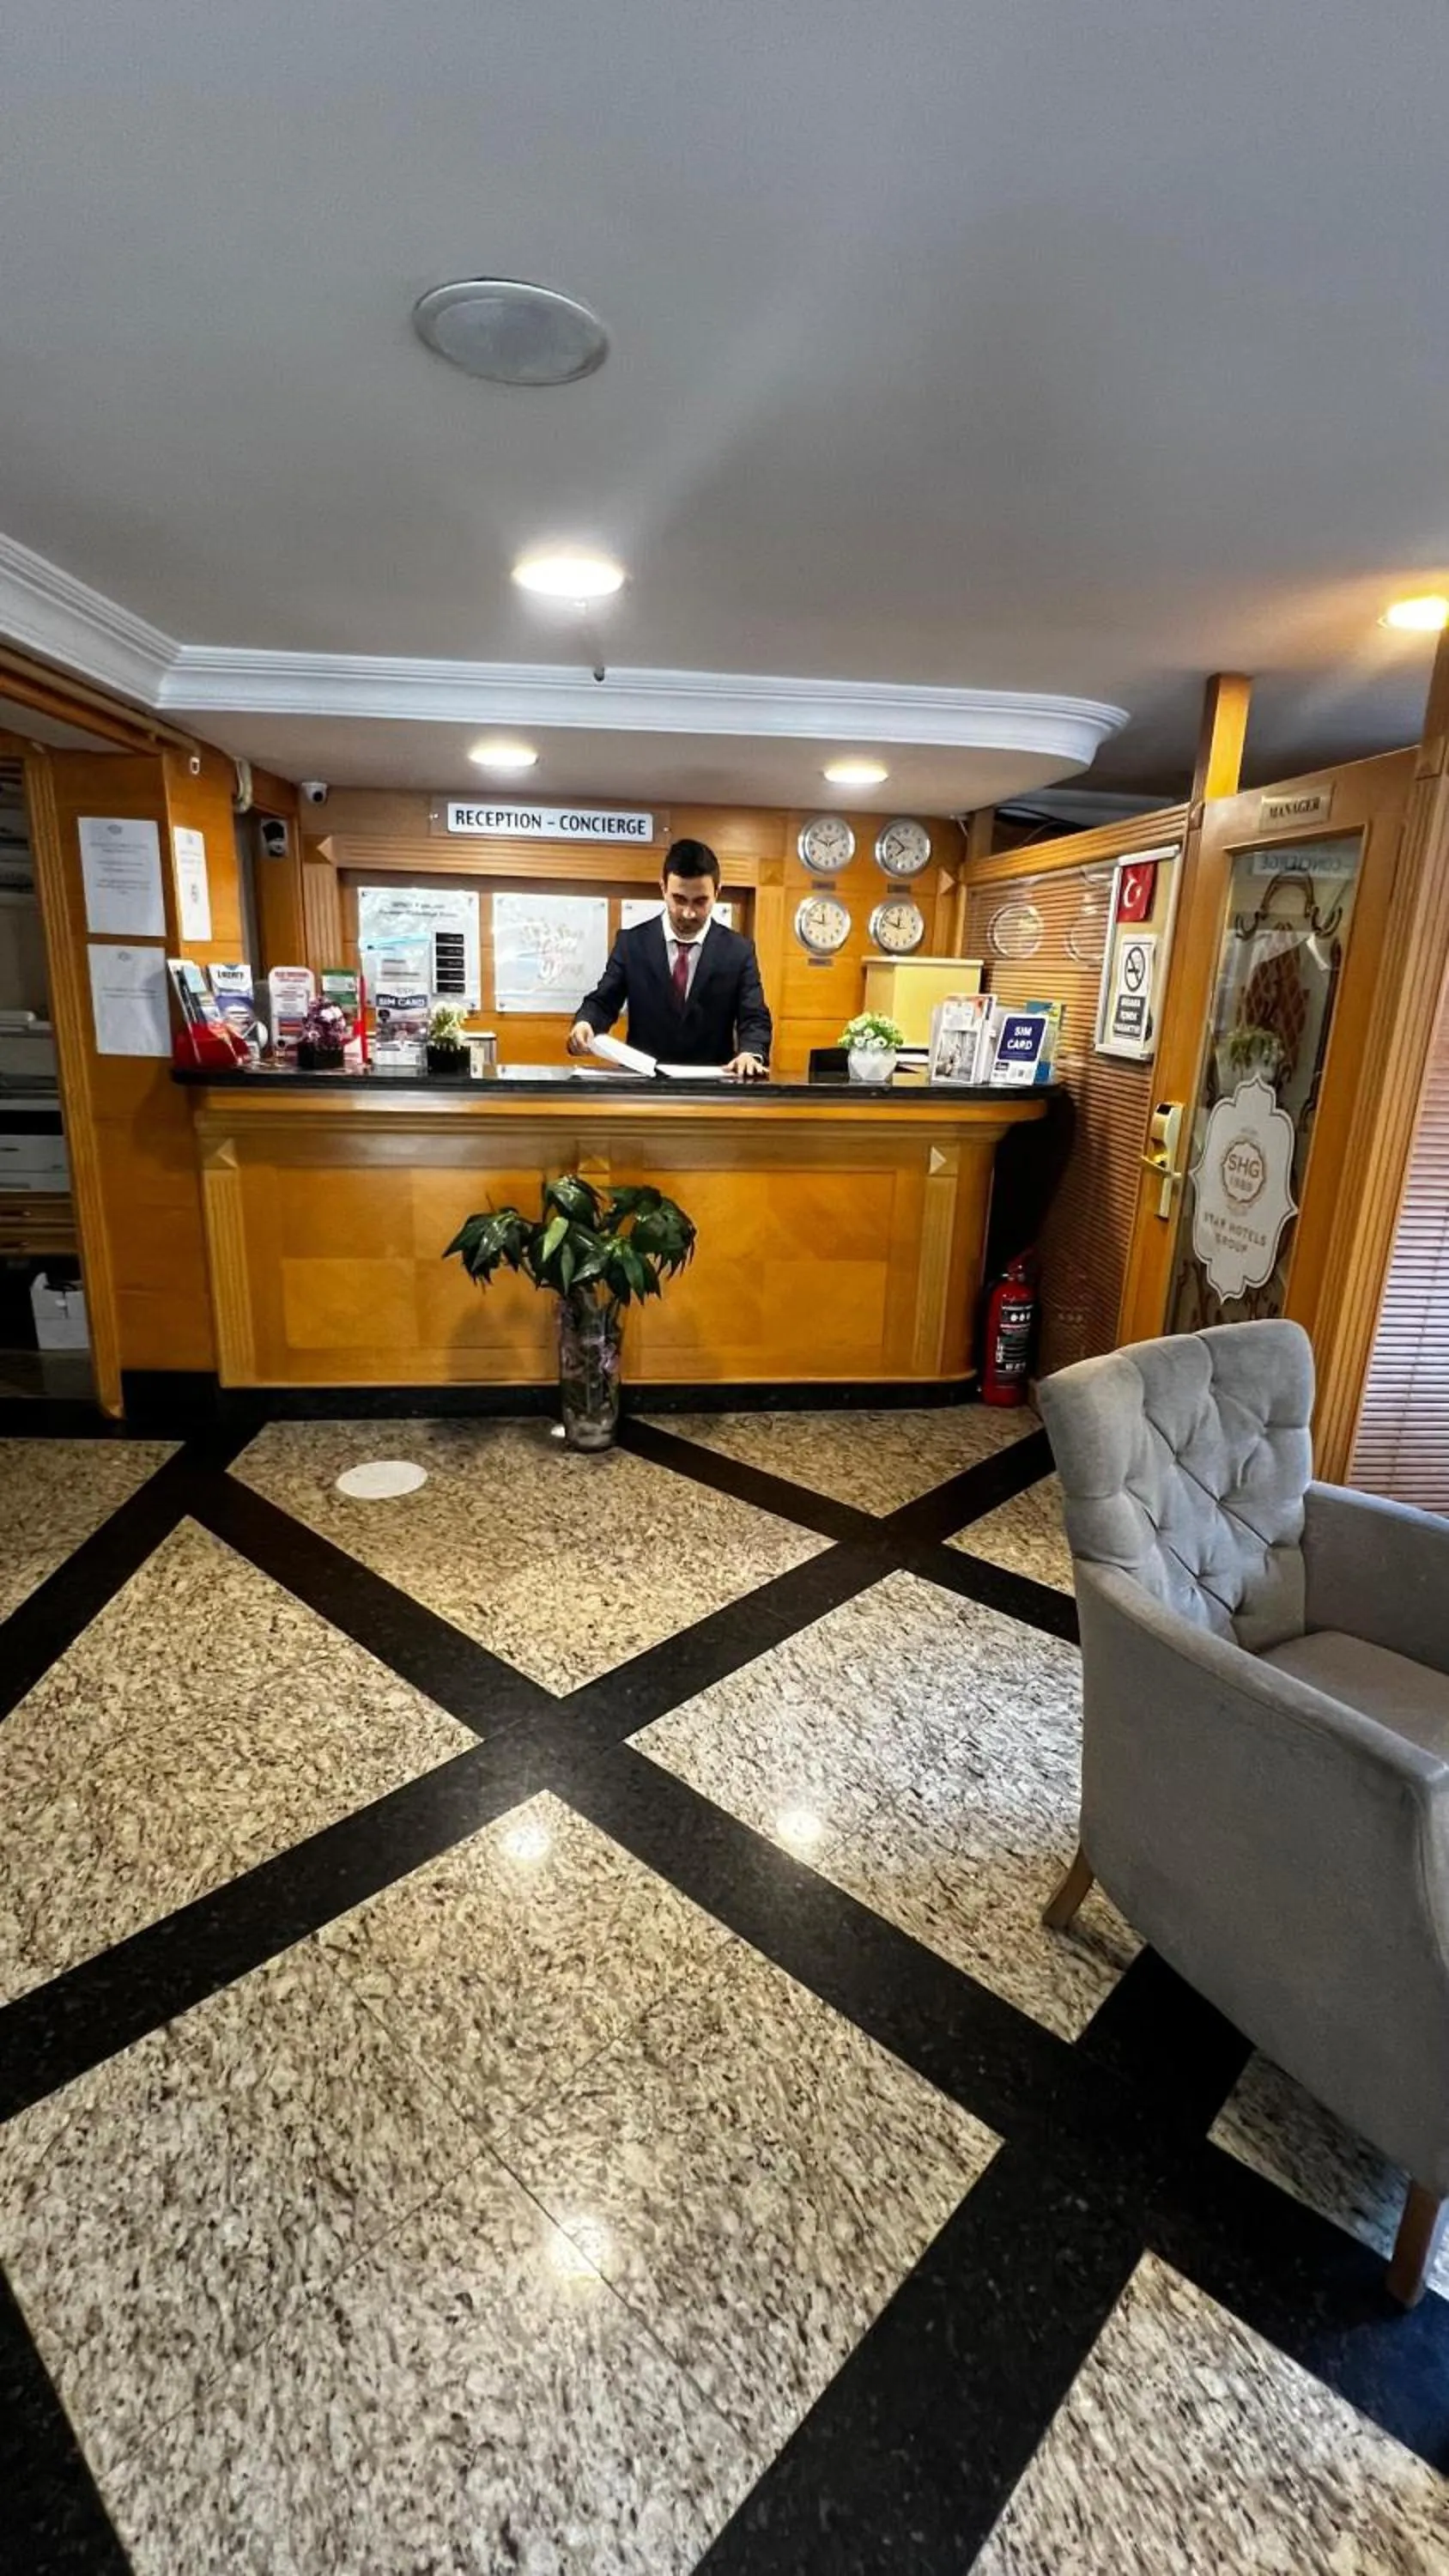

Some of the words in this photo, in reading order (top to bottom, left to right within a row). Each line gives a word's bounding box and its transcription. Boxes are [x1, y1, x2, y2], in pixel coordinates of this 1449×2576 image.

[455, 809, 542, 829] RECEPTION
[560, 815, 646, 835] CONCIERGE
[1015, 1026, 1033, 1036] SIM
[1007, 1040, 1033, 1050] CARD
[1228, 1153, 1260, 1178] SHG
[1228, 1223, 1266, 1247] HOTELS
